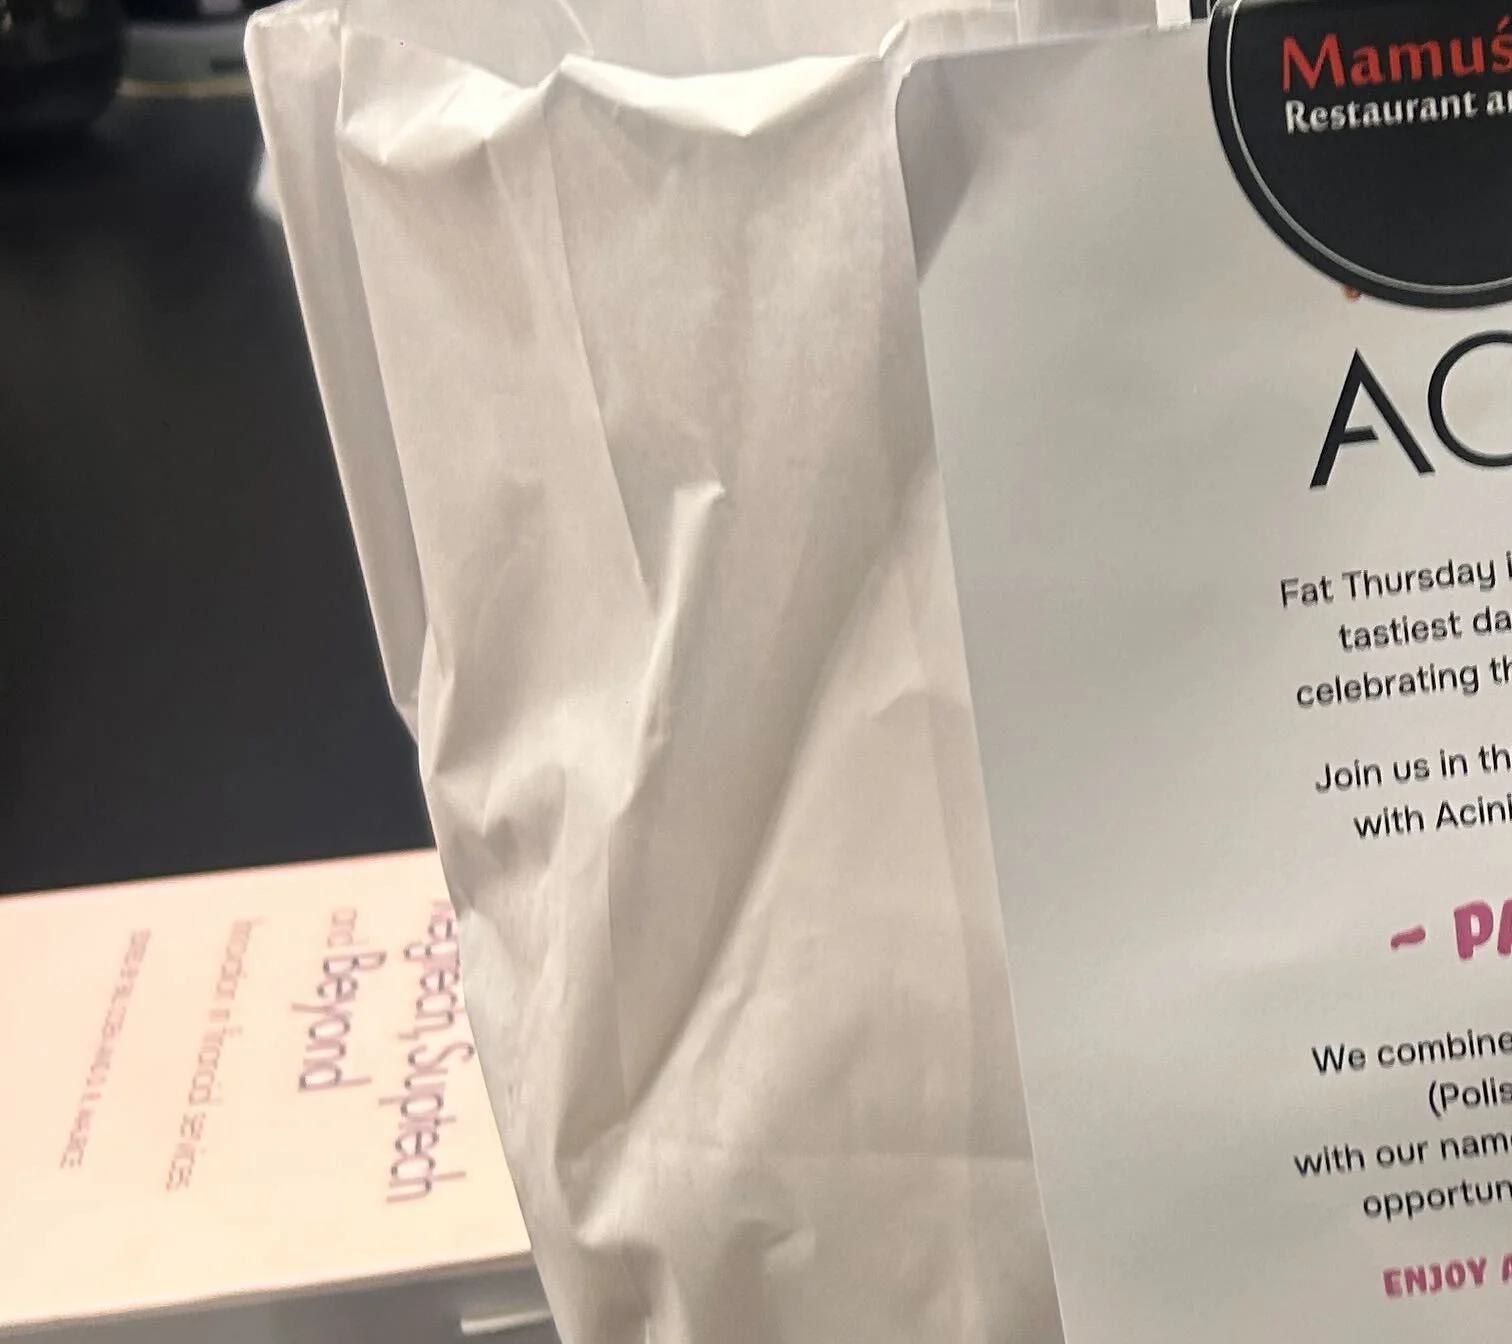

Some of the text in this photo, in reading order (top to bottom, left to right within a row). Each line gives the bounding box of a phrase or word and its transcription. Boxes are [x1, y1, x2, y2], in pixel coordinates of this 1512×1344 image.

[1285, 89, 1478, 135] Restaurant
[1281, 576, 1334, 609] Fat
[1342, 559, 1496, 601] Thursday
[1339, 610, 1462, 652] tastiest
[1297, 663, 1479, 708] celebrating
[1316, 759, 1382, 793] Join
[1393, 758, 1430, 784] us
[1440, 748, 1468, 780] in
[1353, 805, 1424, 840] with
[291, 951, 387, 1093] Beyond
[1311, 1043, 1366, 1075] We
[379, 1041, 476, 1204] Suptech
[1294, 1143, 1365, 1178] with
[1376, 1141, 1428, 1168] our
[1383, 1257, 1487, 1298] ENJOY
